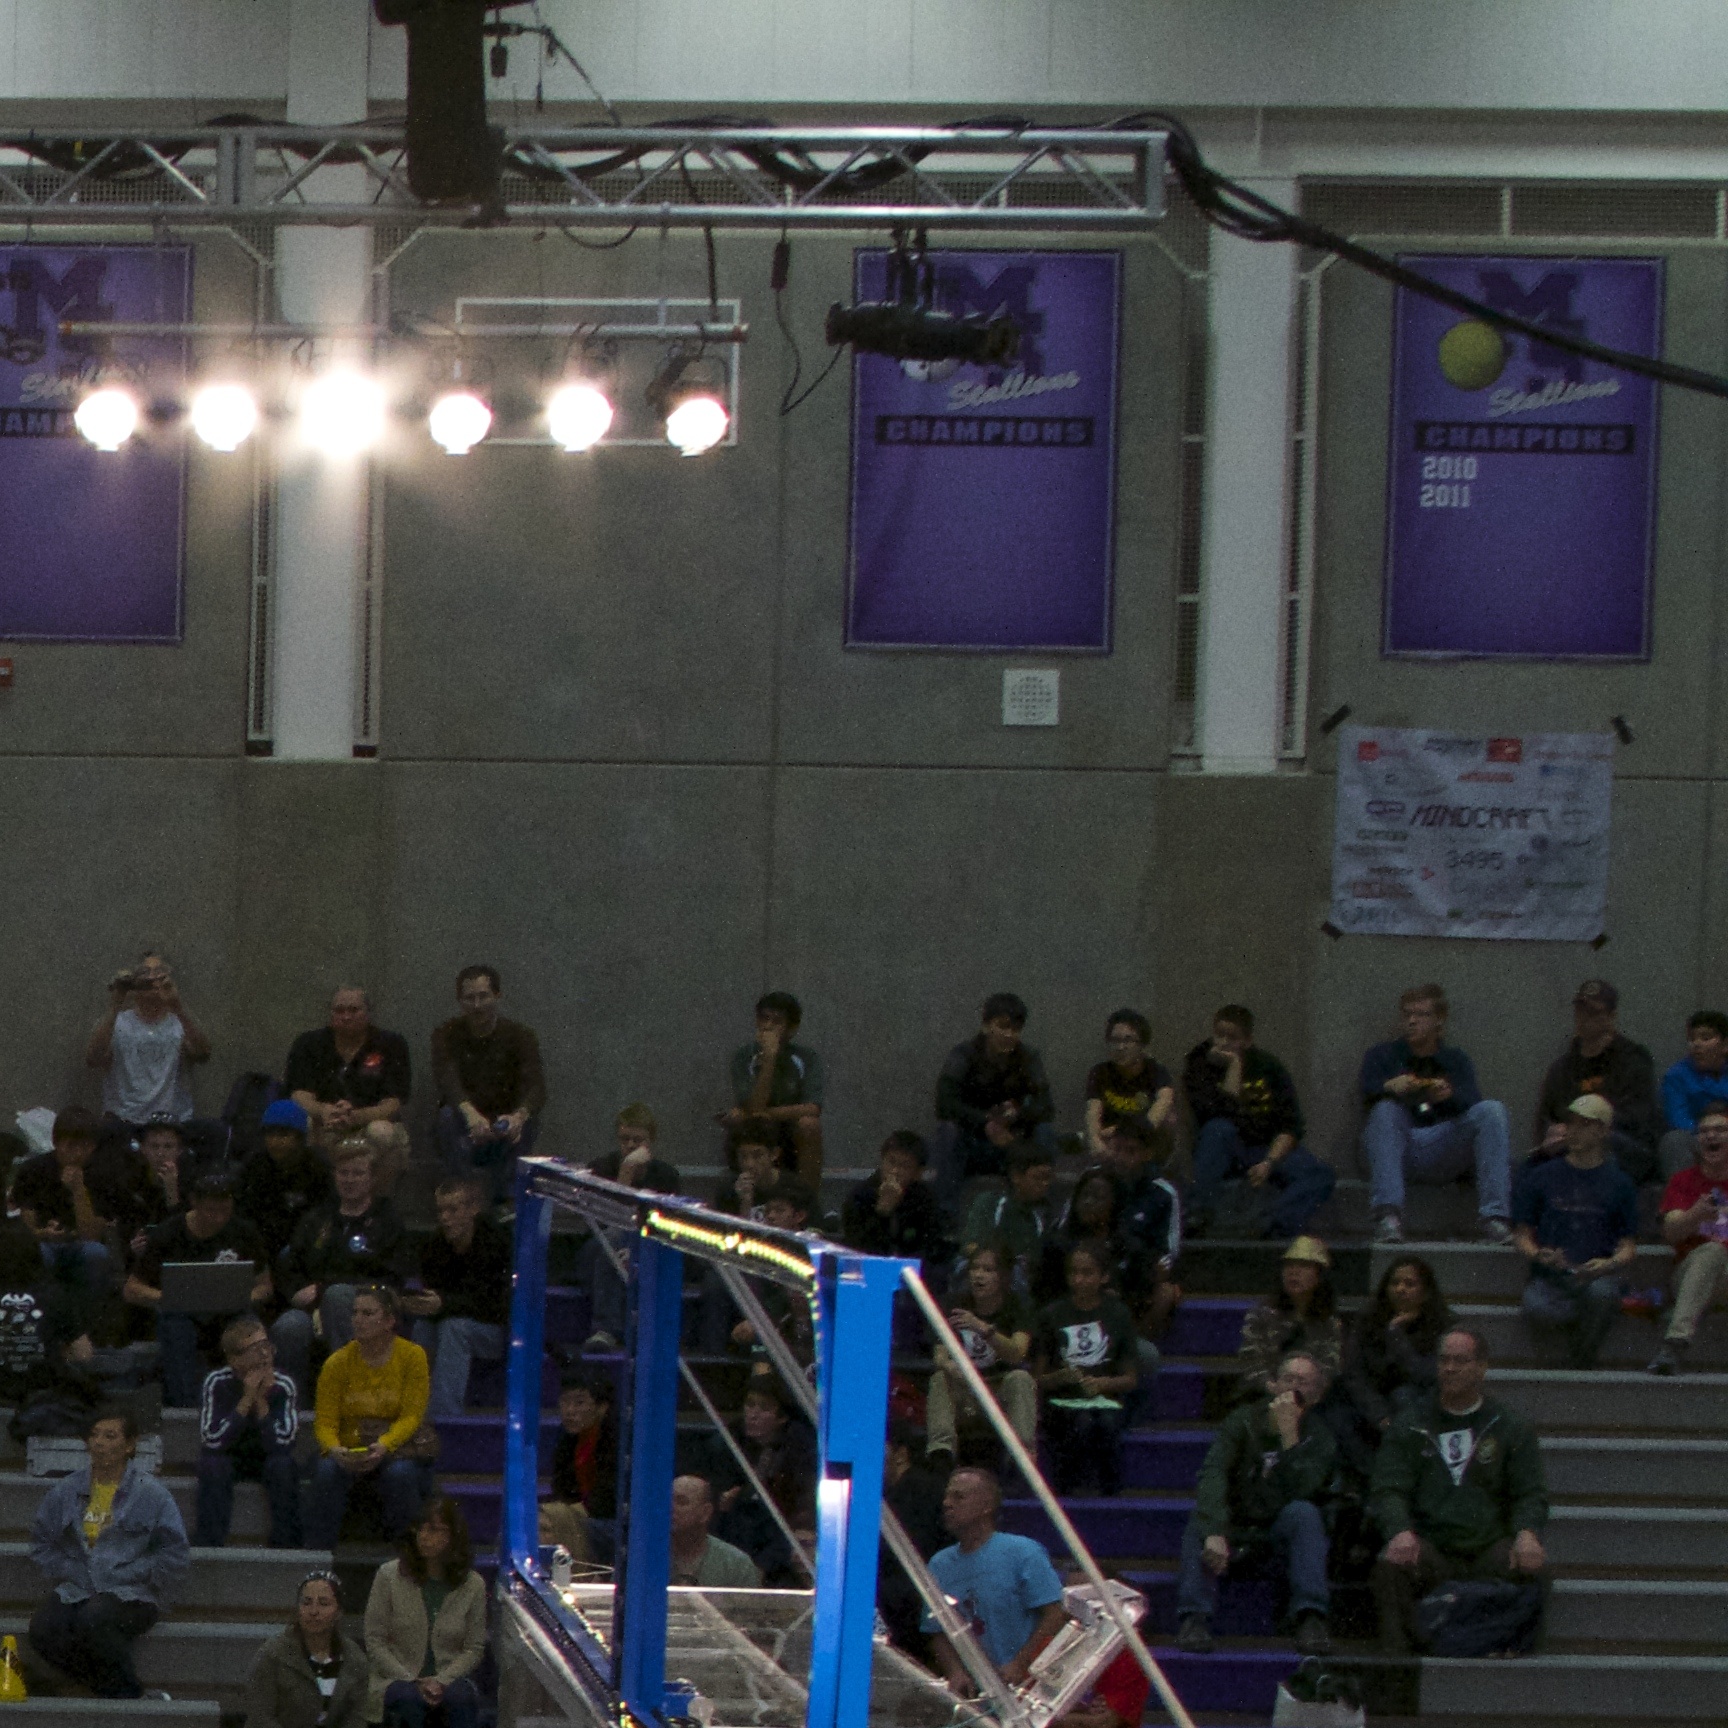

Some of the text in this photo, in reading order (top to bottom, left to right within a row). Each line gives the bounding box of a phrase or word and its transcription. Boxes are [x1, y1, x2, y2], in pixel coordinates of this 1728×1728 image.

[886, 420, 1087, 443] CHAMPIONS
[1424, 426, 1627, 450] CHAMPIONS
[1422, 456, 1478, 480] 2010
[1420, 484, 1472, 508] 2011
